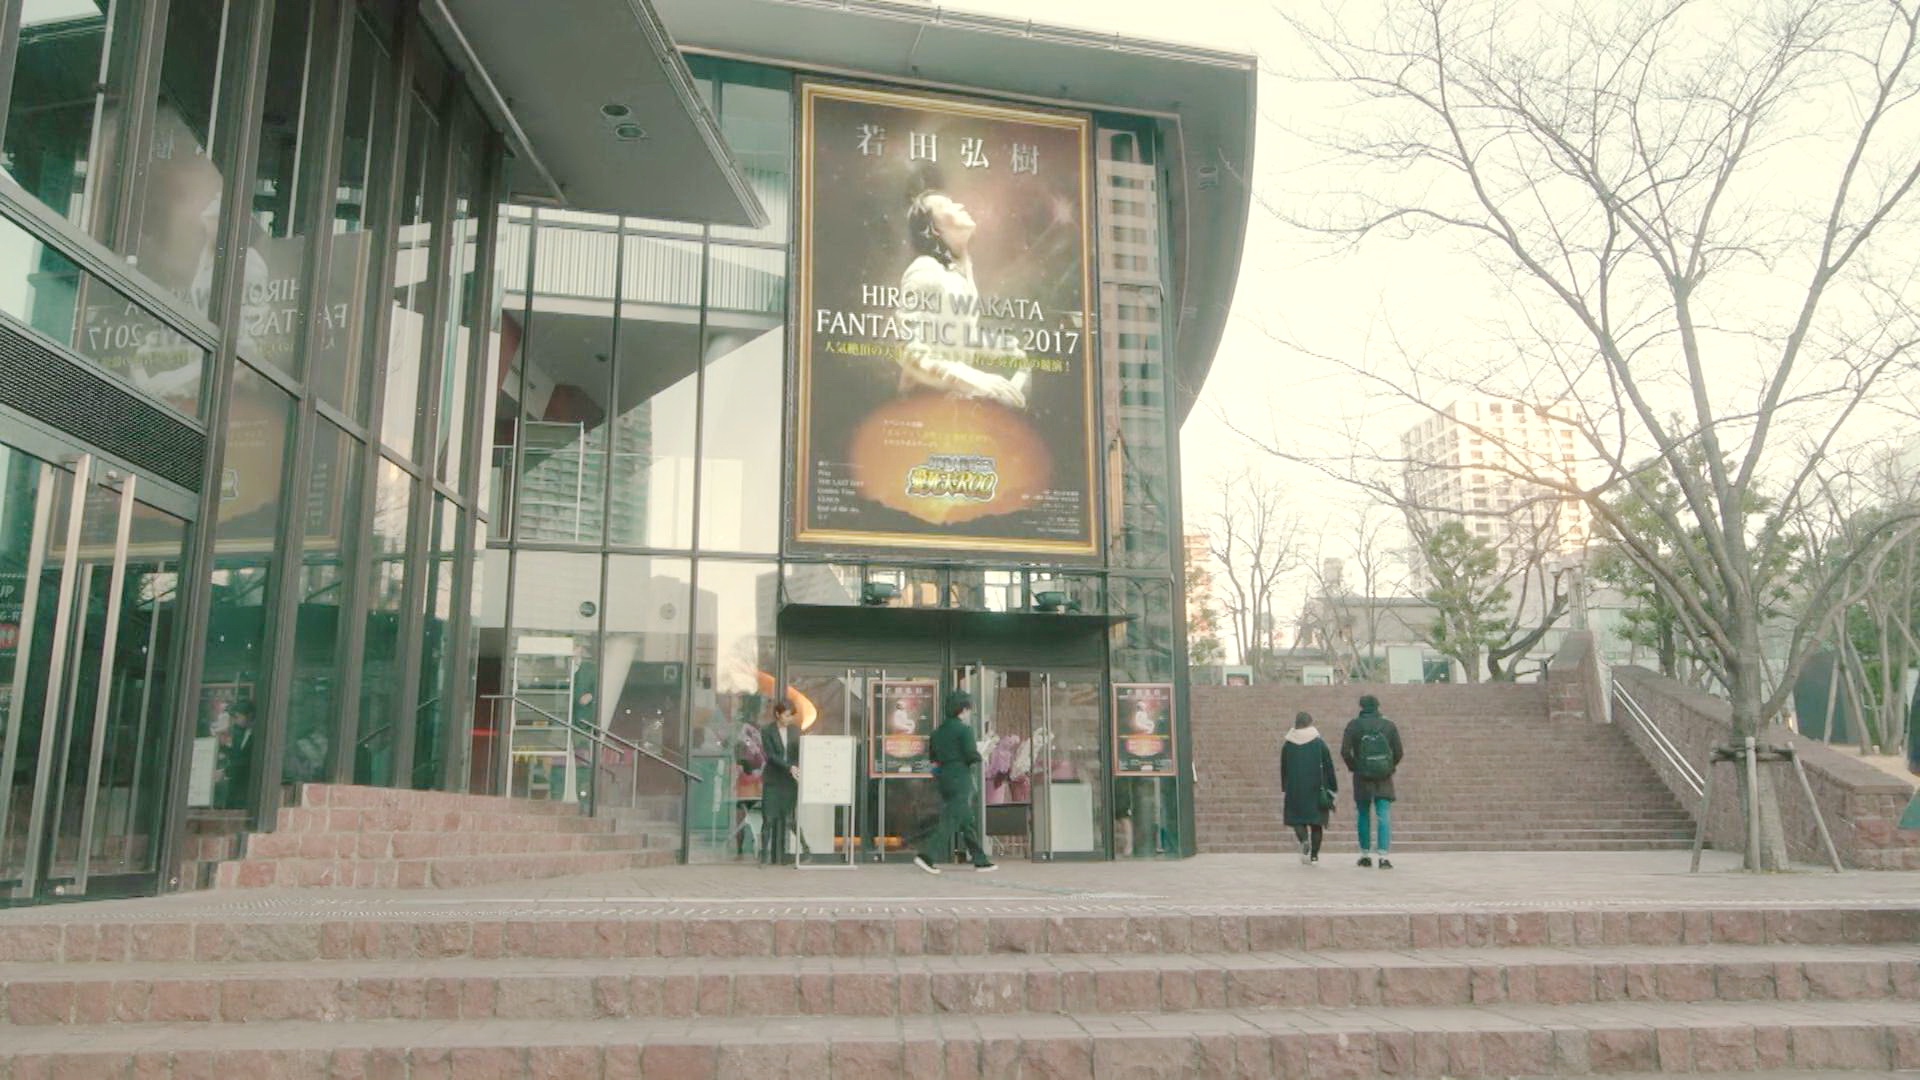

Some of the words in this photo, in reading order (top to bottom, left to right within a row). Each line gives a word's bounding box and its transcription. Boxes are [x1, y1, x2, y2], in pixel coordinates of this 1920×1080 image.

[863, 285, 942, 313] HIROKI
[950, 294, 1044, 321] WAKATA
[816, 309, 956, 347] FANTASTIC
[962, 322, 1017, 351] LIVE
[1023, 328, 1079, 354] 2017
